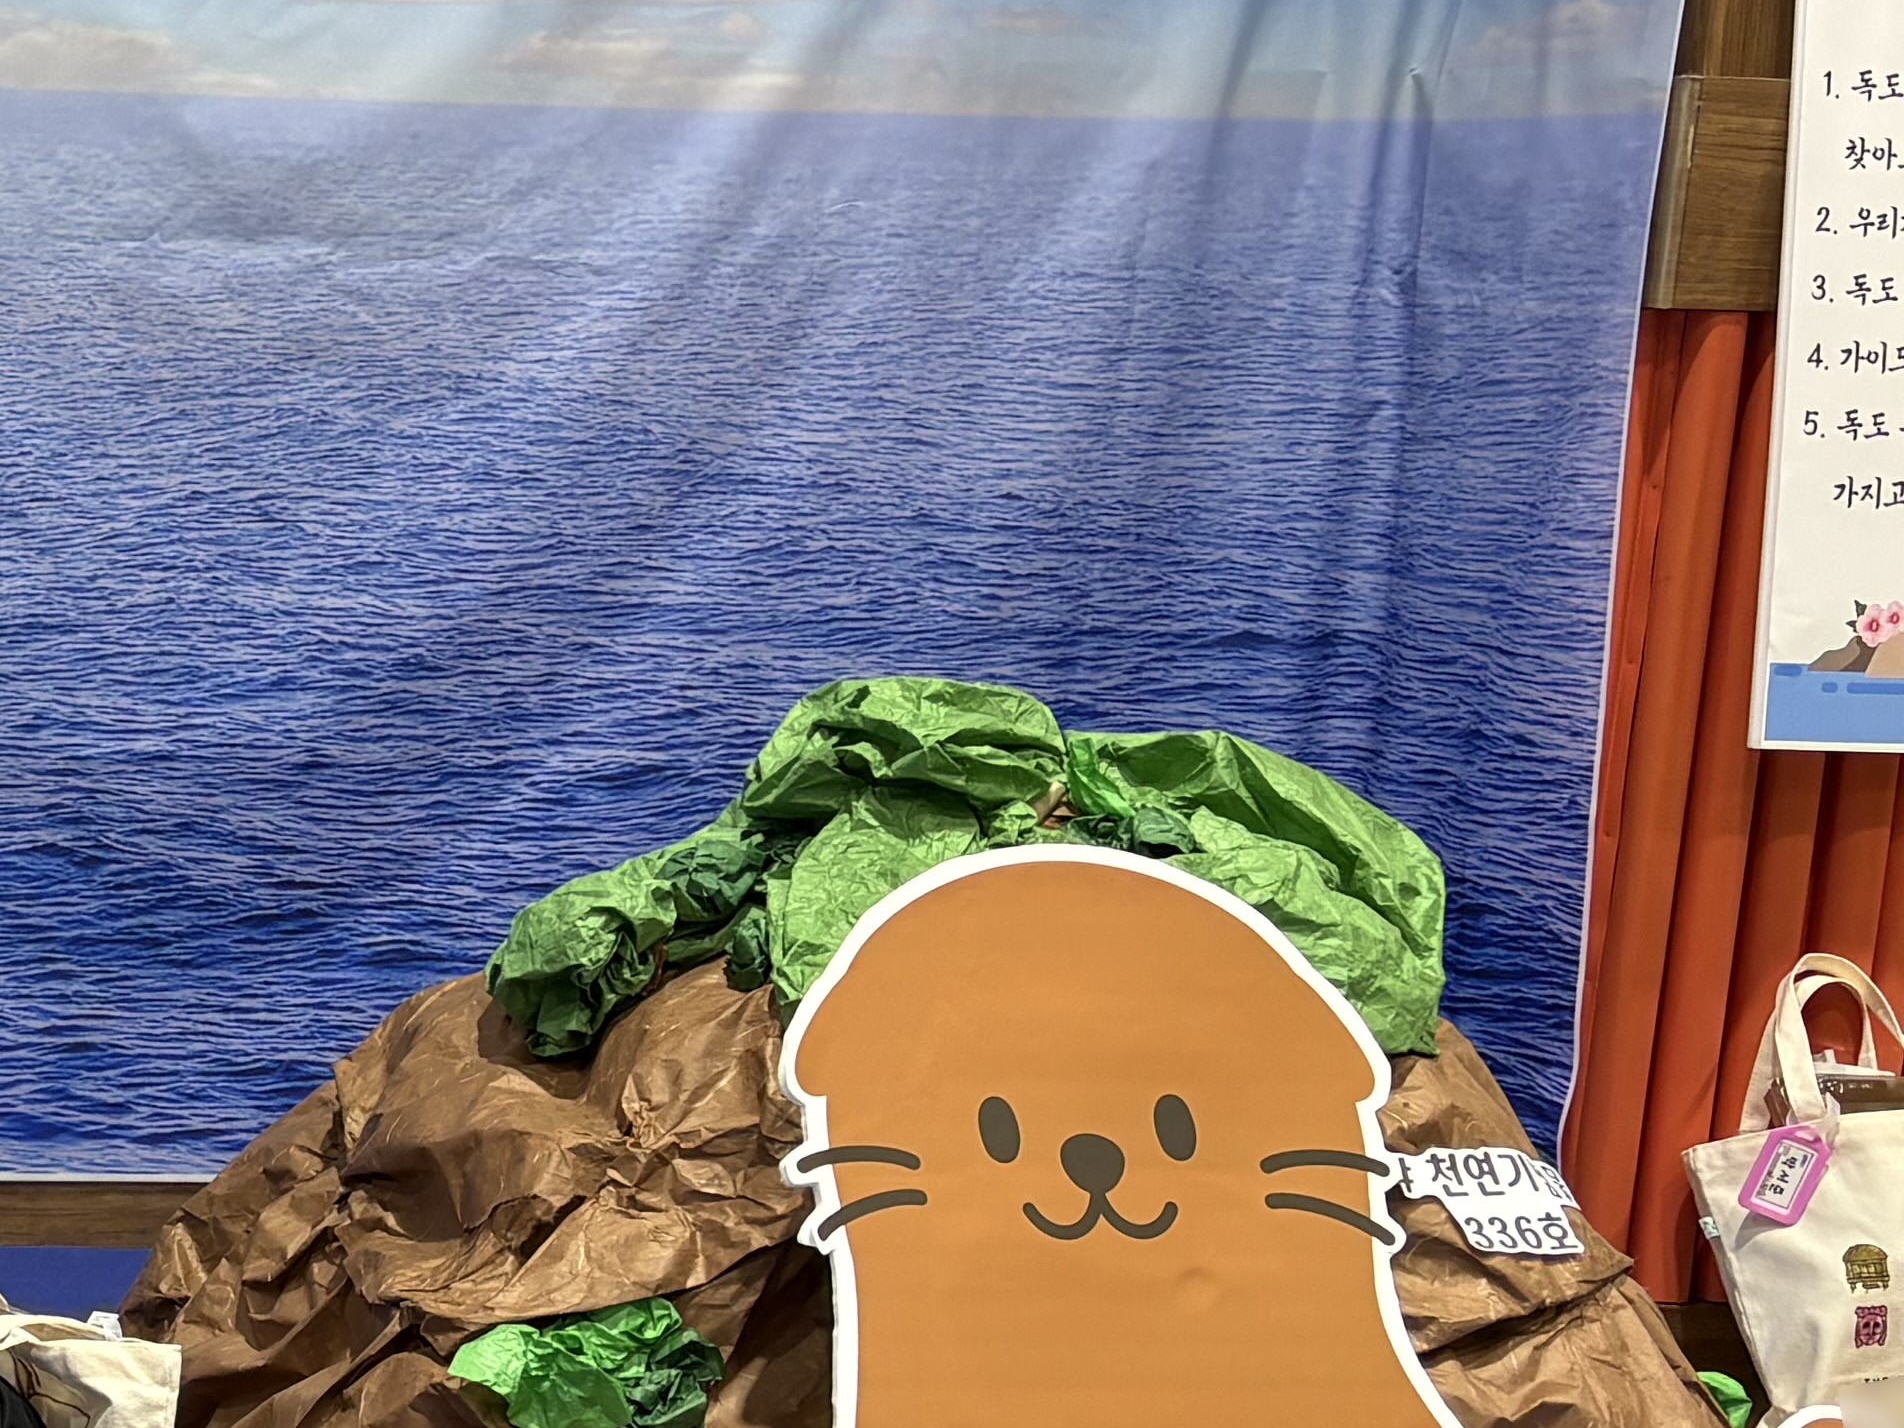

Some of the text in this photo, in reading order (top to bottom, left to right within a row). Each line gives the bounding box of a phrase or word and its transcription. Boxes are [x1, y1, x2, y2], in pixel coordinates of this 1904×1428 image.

[1823, 70, 1841, 100] 1.
[1844, 136, 1904, 171] 찾아
[1815, 205, 1904, 240] 2. 우리
[1811, 273, 1899, 307] 3. 독도
[1807, 342, 1829, 371] 4.
[1803, 408, 1890, 442] 5. 독도
[1463, 1212, 1579, 1251] 336호
